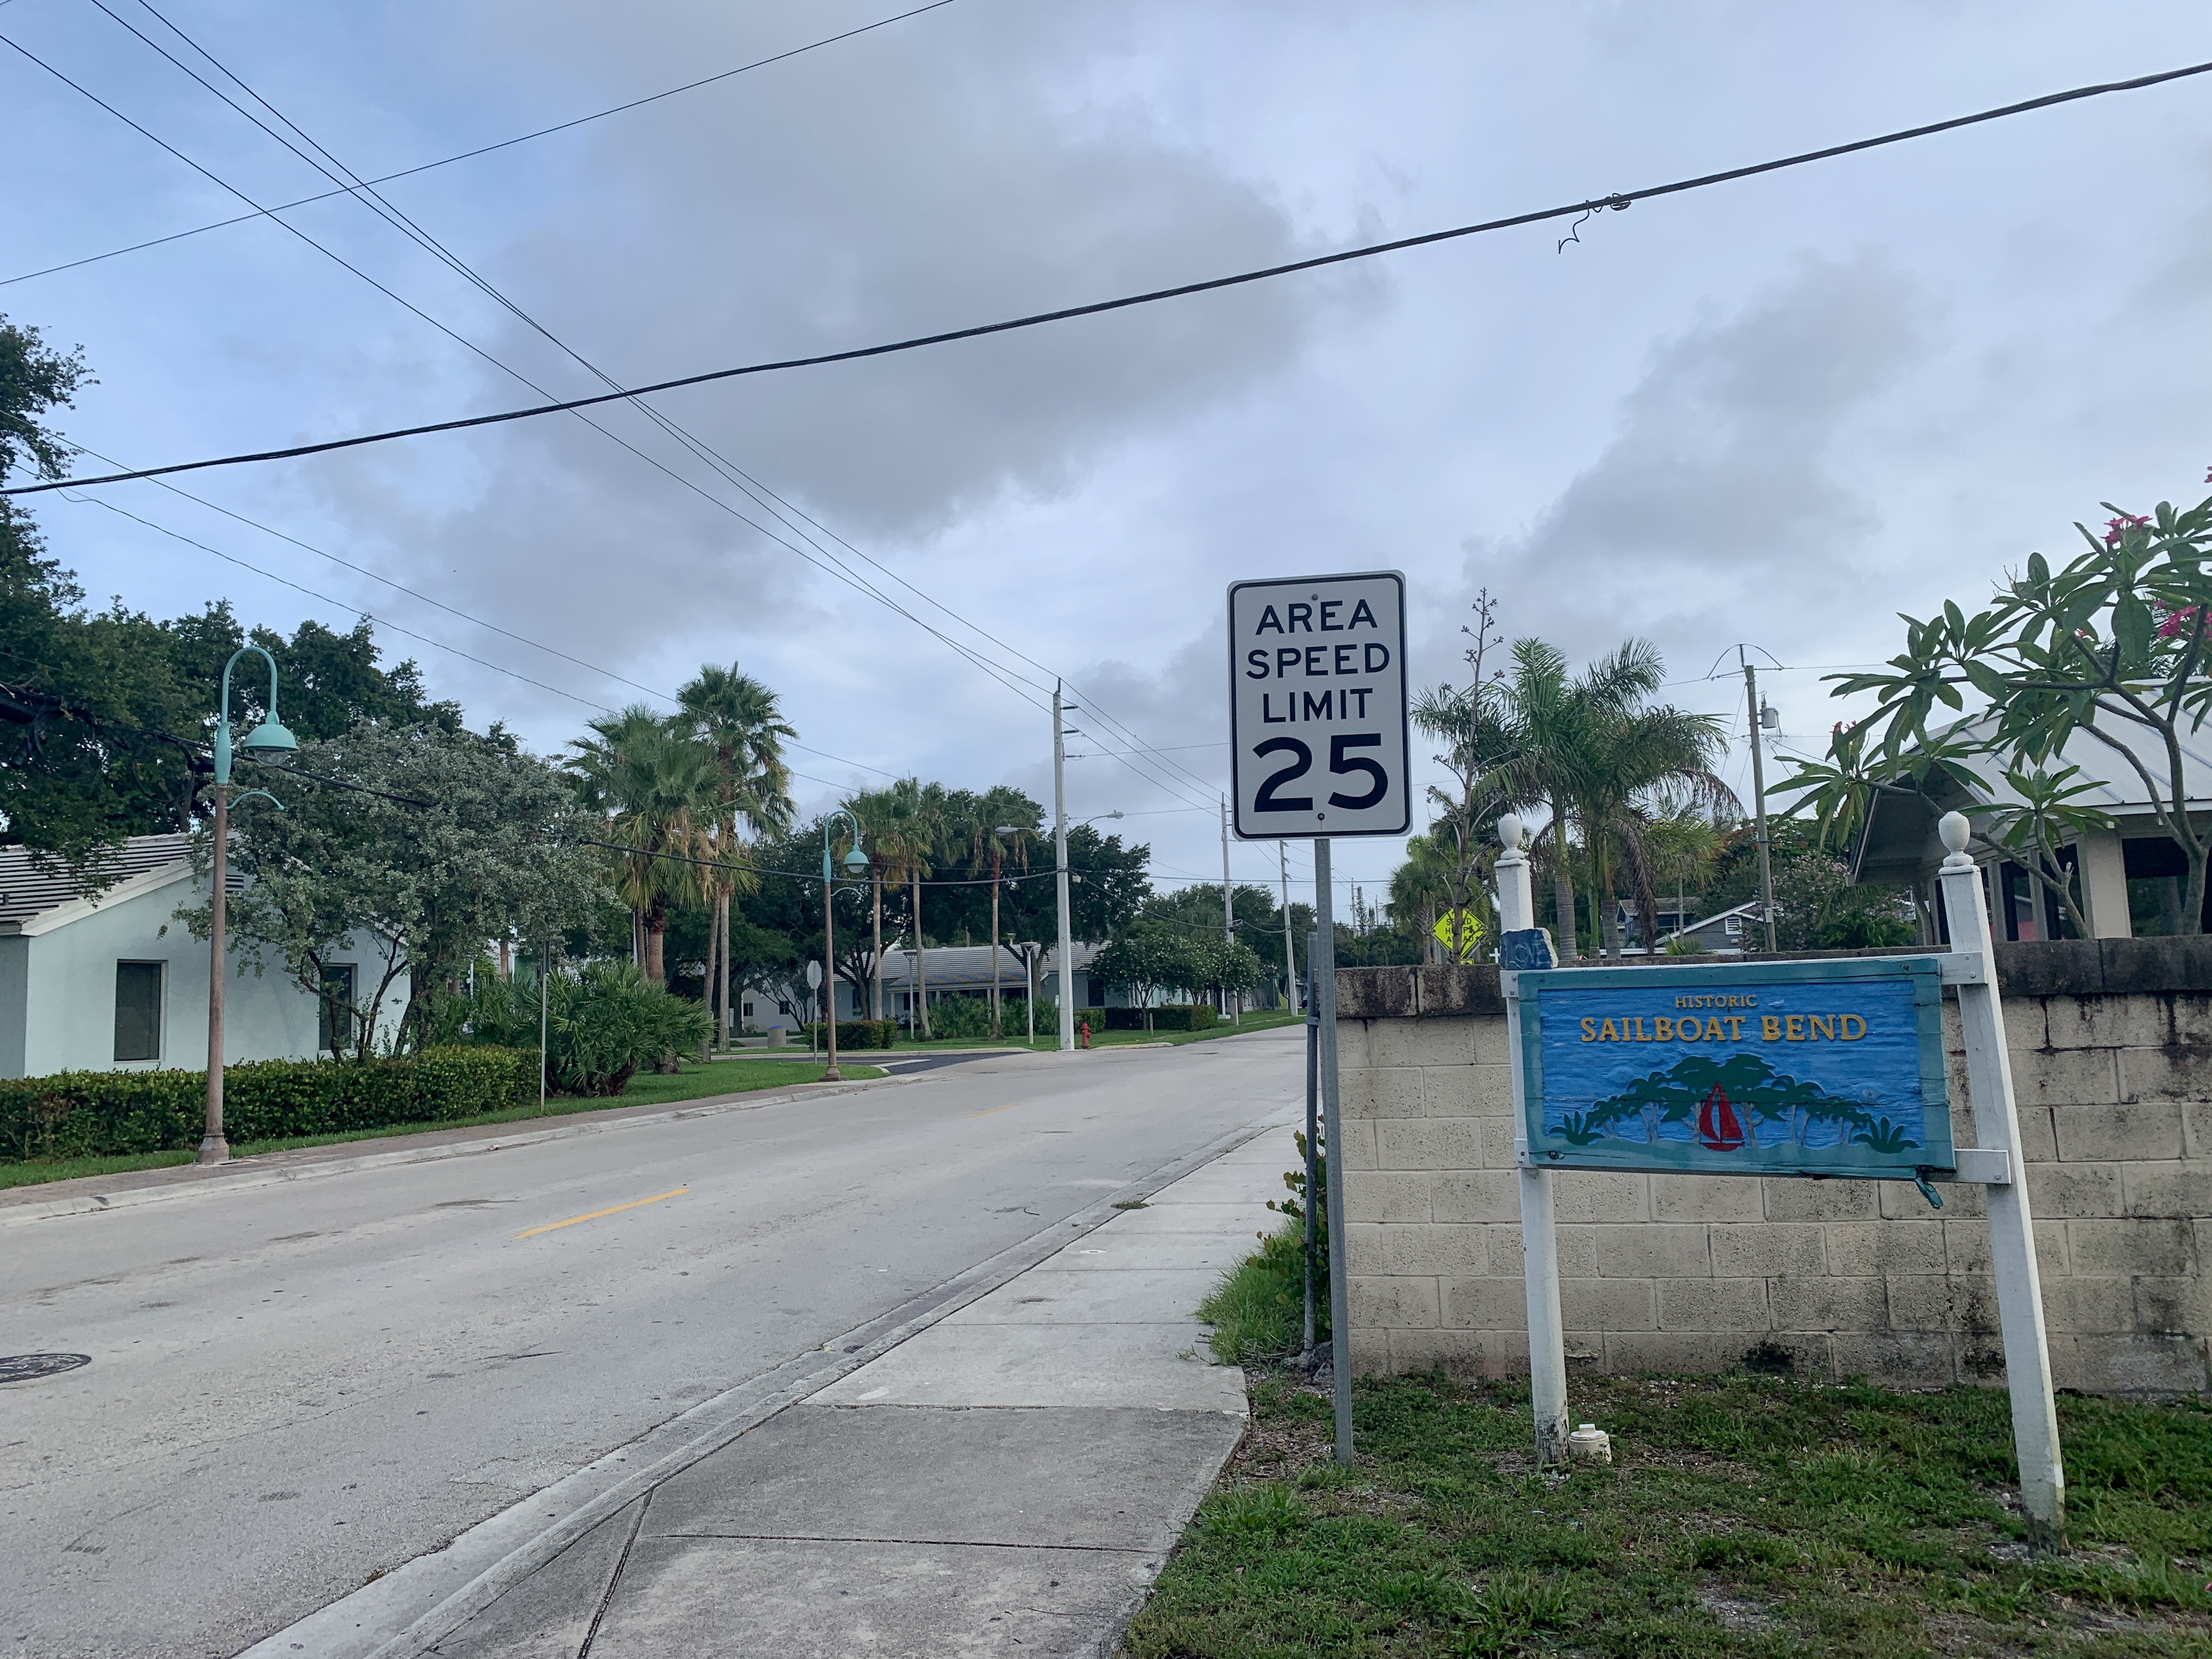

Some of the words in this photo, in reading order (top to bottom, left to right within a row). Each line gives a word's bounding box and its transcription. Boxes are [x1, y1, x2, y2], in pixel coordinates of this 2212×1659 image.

[1255, 599, 1378, 635] AREA
[1246, 642, 1390, 680] SPEED
[1263, 687, 1373, 724] LIMIT
[1252, 732, 1389, 813] 25
[1674, 995, 1757, 1008] HISTORIC
[1580, 1016, 1747, 1042] SAILBOAT
[1761, 1014, 1866, 1041] BEND
